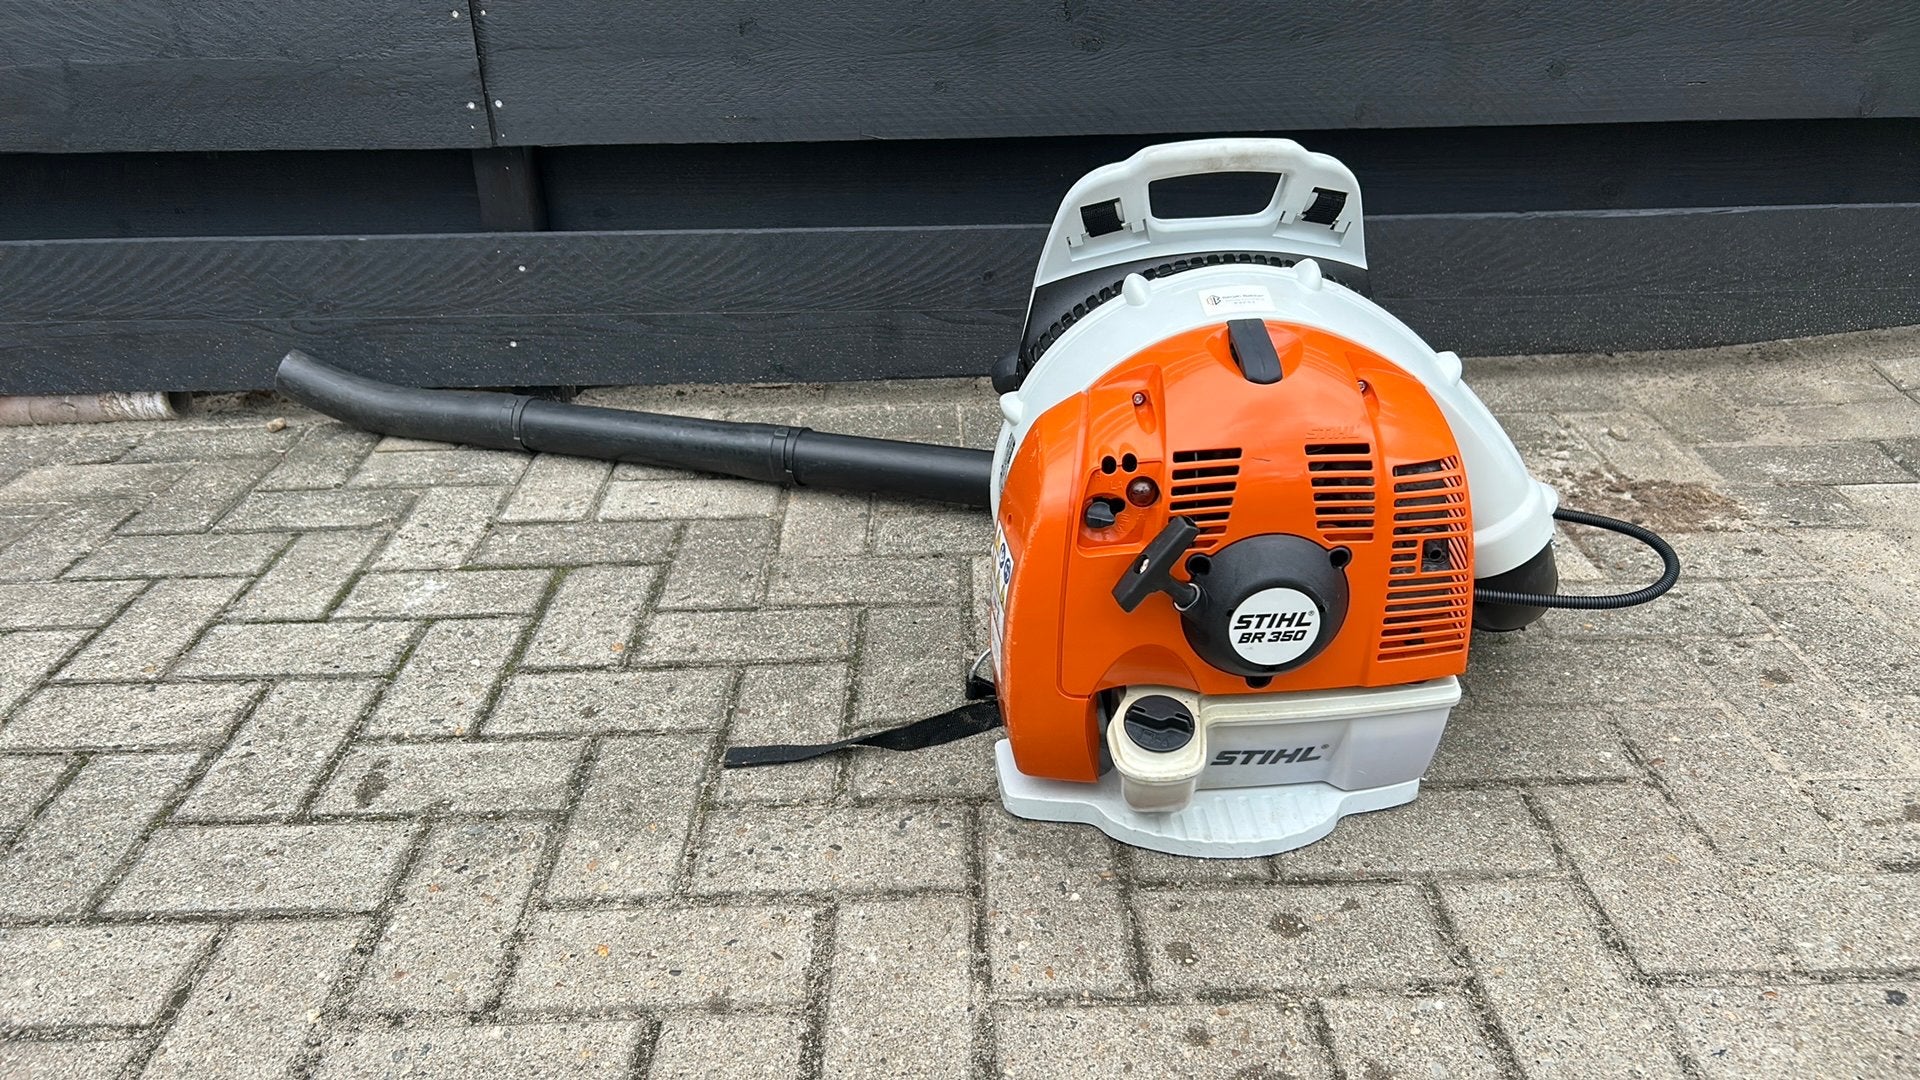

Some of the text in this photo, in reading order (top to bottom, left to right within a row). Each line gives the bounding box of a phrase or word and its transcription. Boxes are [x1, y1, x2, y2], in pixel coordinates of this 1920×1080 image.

[1233, 611, 1312, 630] STIHL
[1238, 630, 1307, 644] BR 350
[1210, 746, 1321, 766] STIHL
